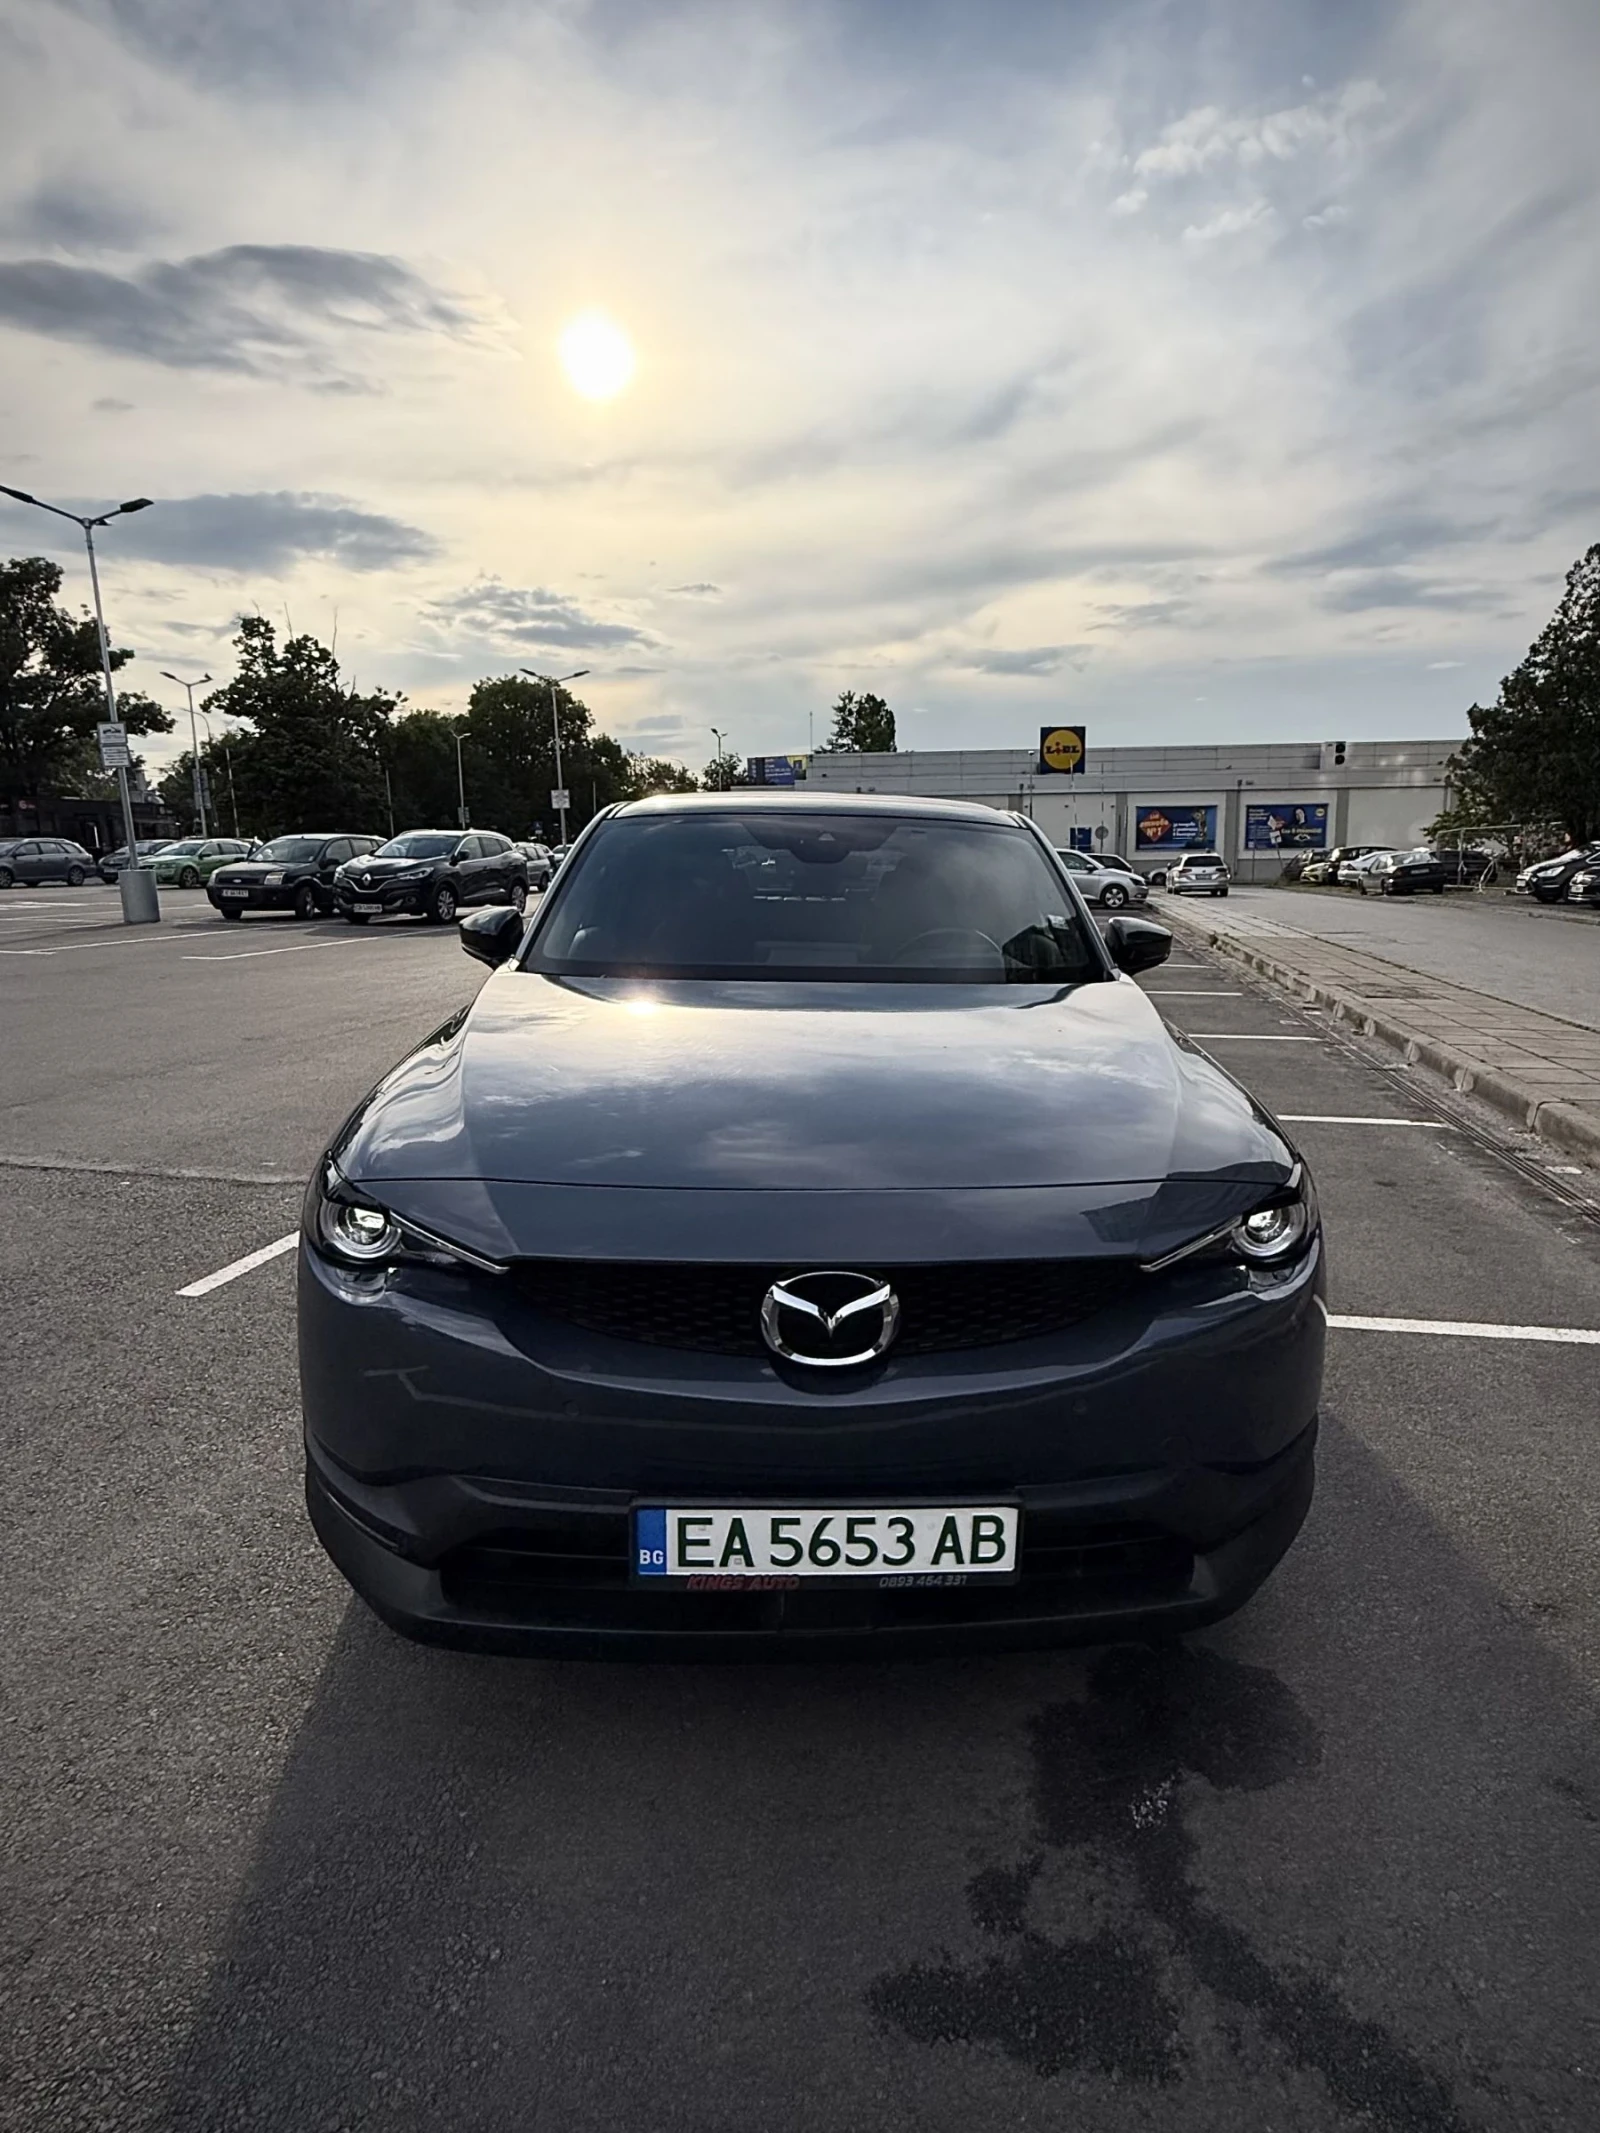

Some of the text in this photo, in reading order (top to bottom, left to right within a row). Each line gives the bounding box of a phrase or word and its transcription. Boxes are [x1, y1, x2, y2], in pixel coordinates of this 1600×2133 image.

[677, 1515, 1006, 1568] EA 5653 AB
[640, 1550, 664, 1564] BG
[686, 1575, 800, 1590] KINGS AUTO
[880, 1576, 914, 1588] 0893
[944, 1574, 967, 1586] 331
